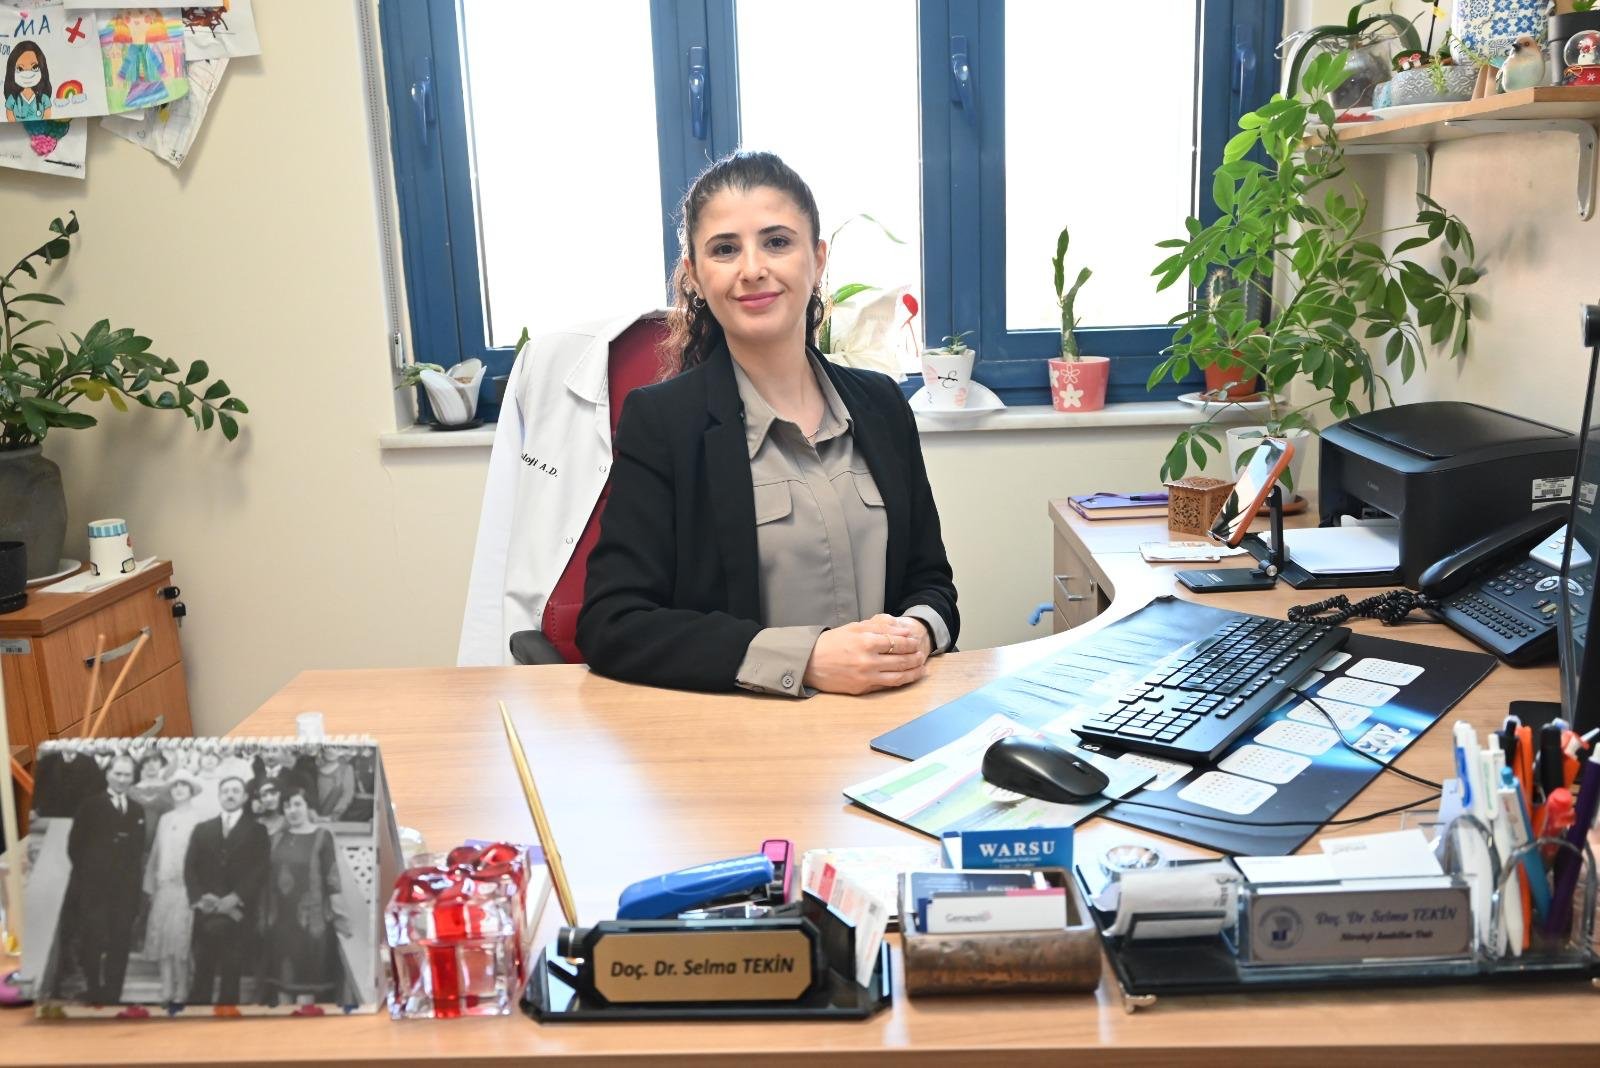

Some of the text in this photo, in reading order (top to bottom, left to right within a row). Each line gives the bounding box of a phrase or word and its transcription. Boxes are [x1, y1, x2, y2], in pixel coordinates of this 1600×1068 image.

[979, 840, 1055, 857] WARSU
[611, 953, 794, 980] Doç. Dr. Selma TEKİN
